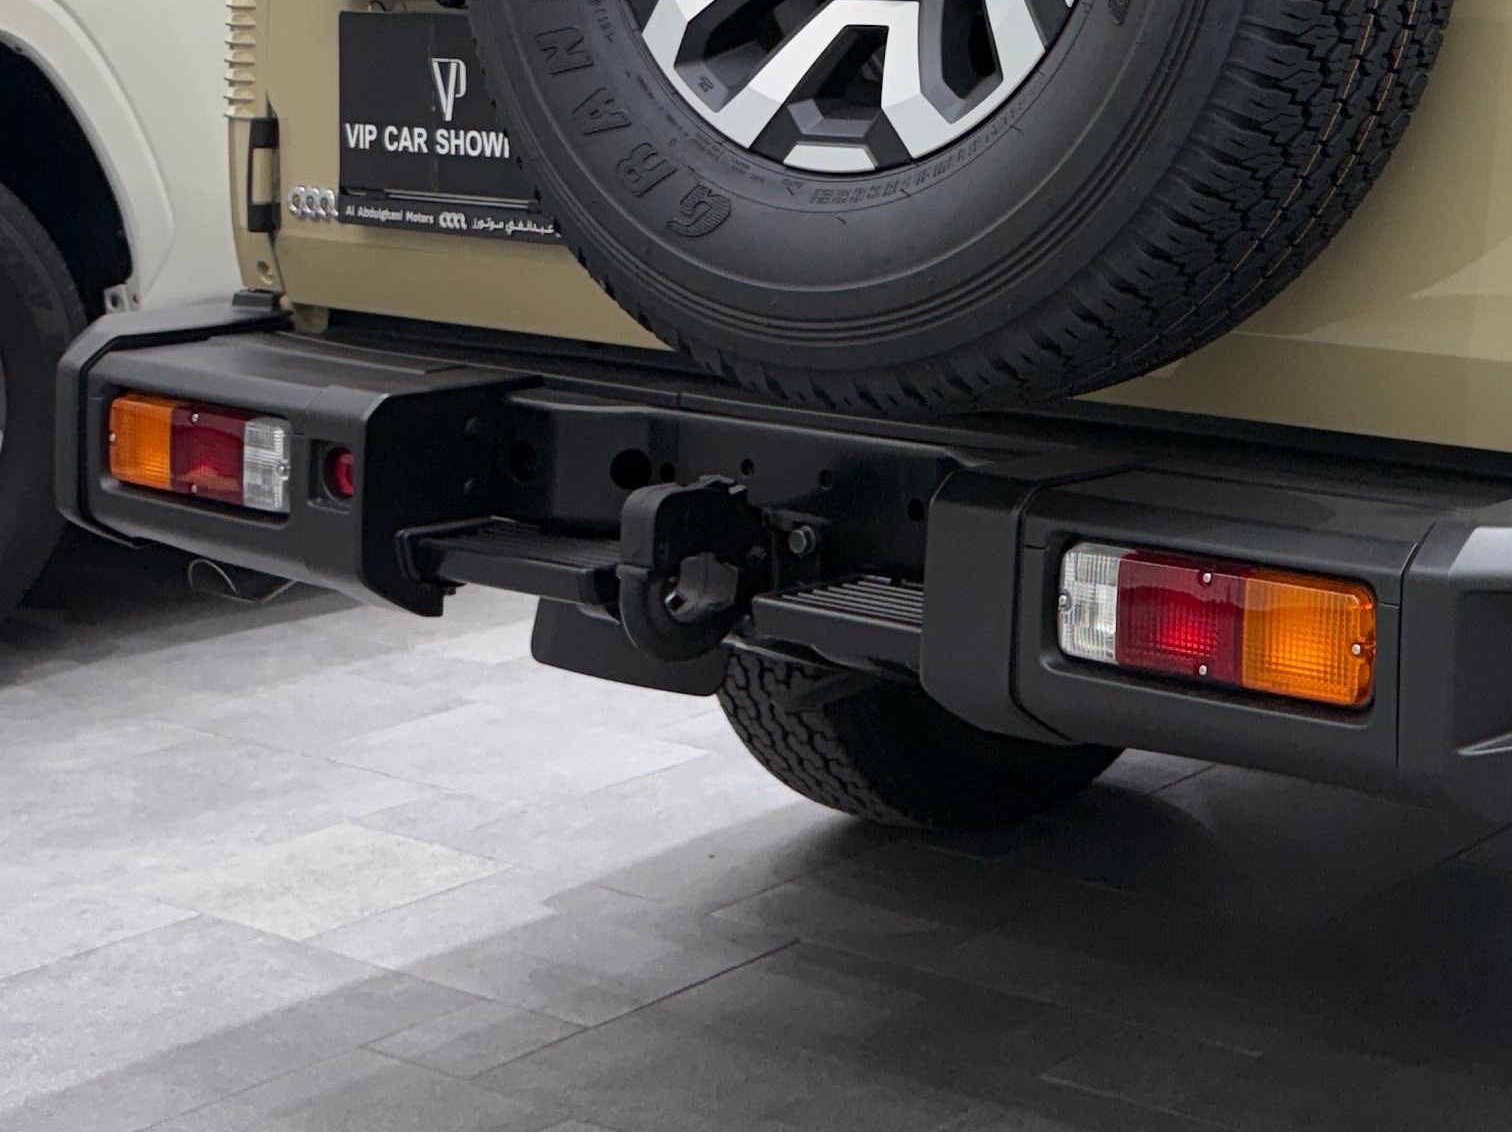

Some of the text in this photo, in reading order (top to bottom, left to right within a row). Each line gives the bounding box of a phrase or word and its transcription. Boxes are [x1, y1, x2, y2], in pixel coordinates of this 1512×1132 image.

[345, 123, 378, 150] VIP
[384, 125, 429, 154] CAR
[405, 211, 434, 225] Motors
